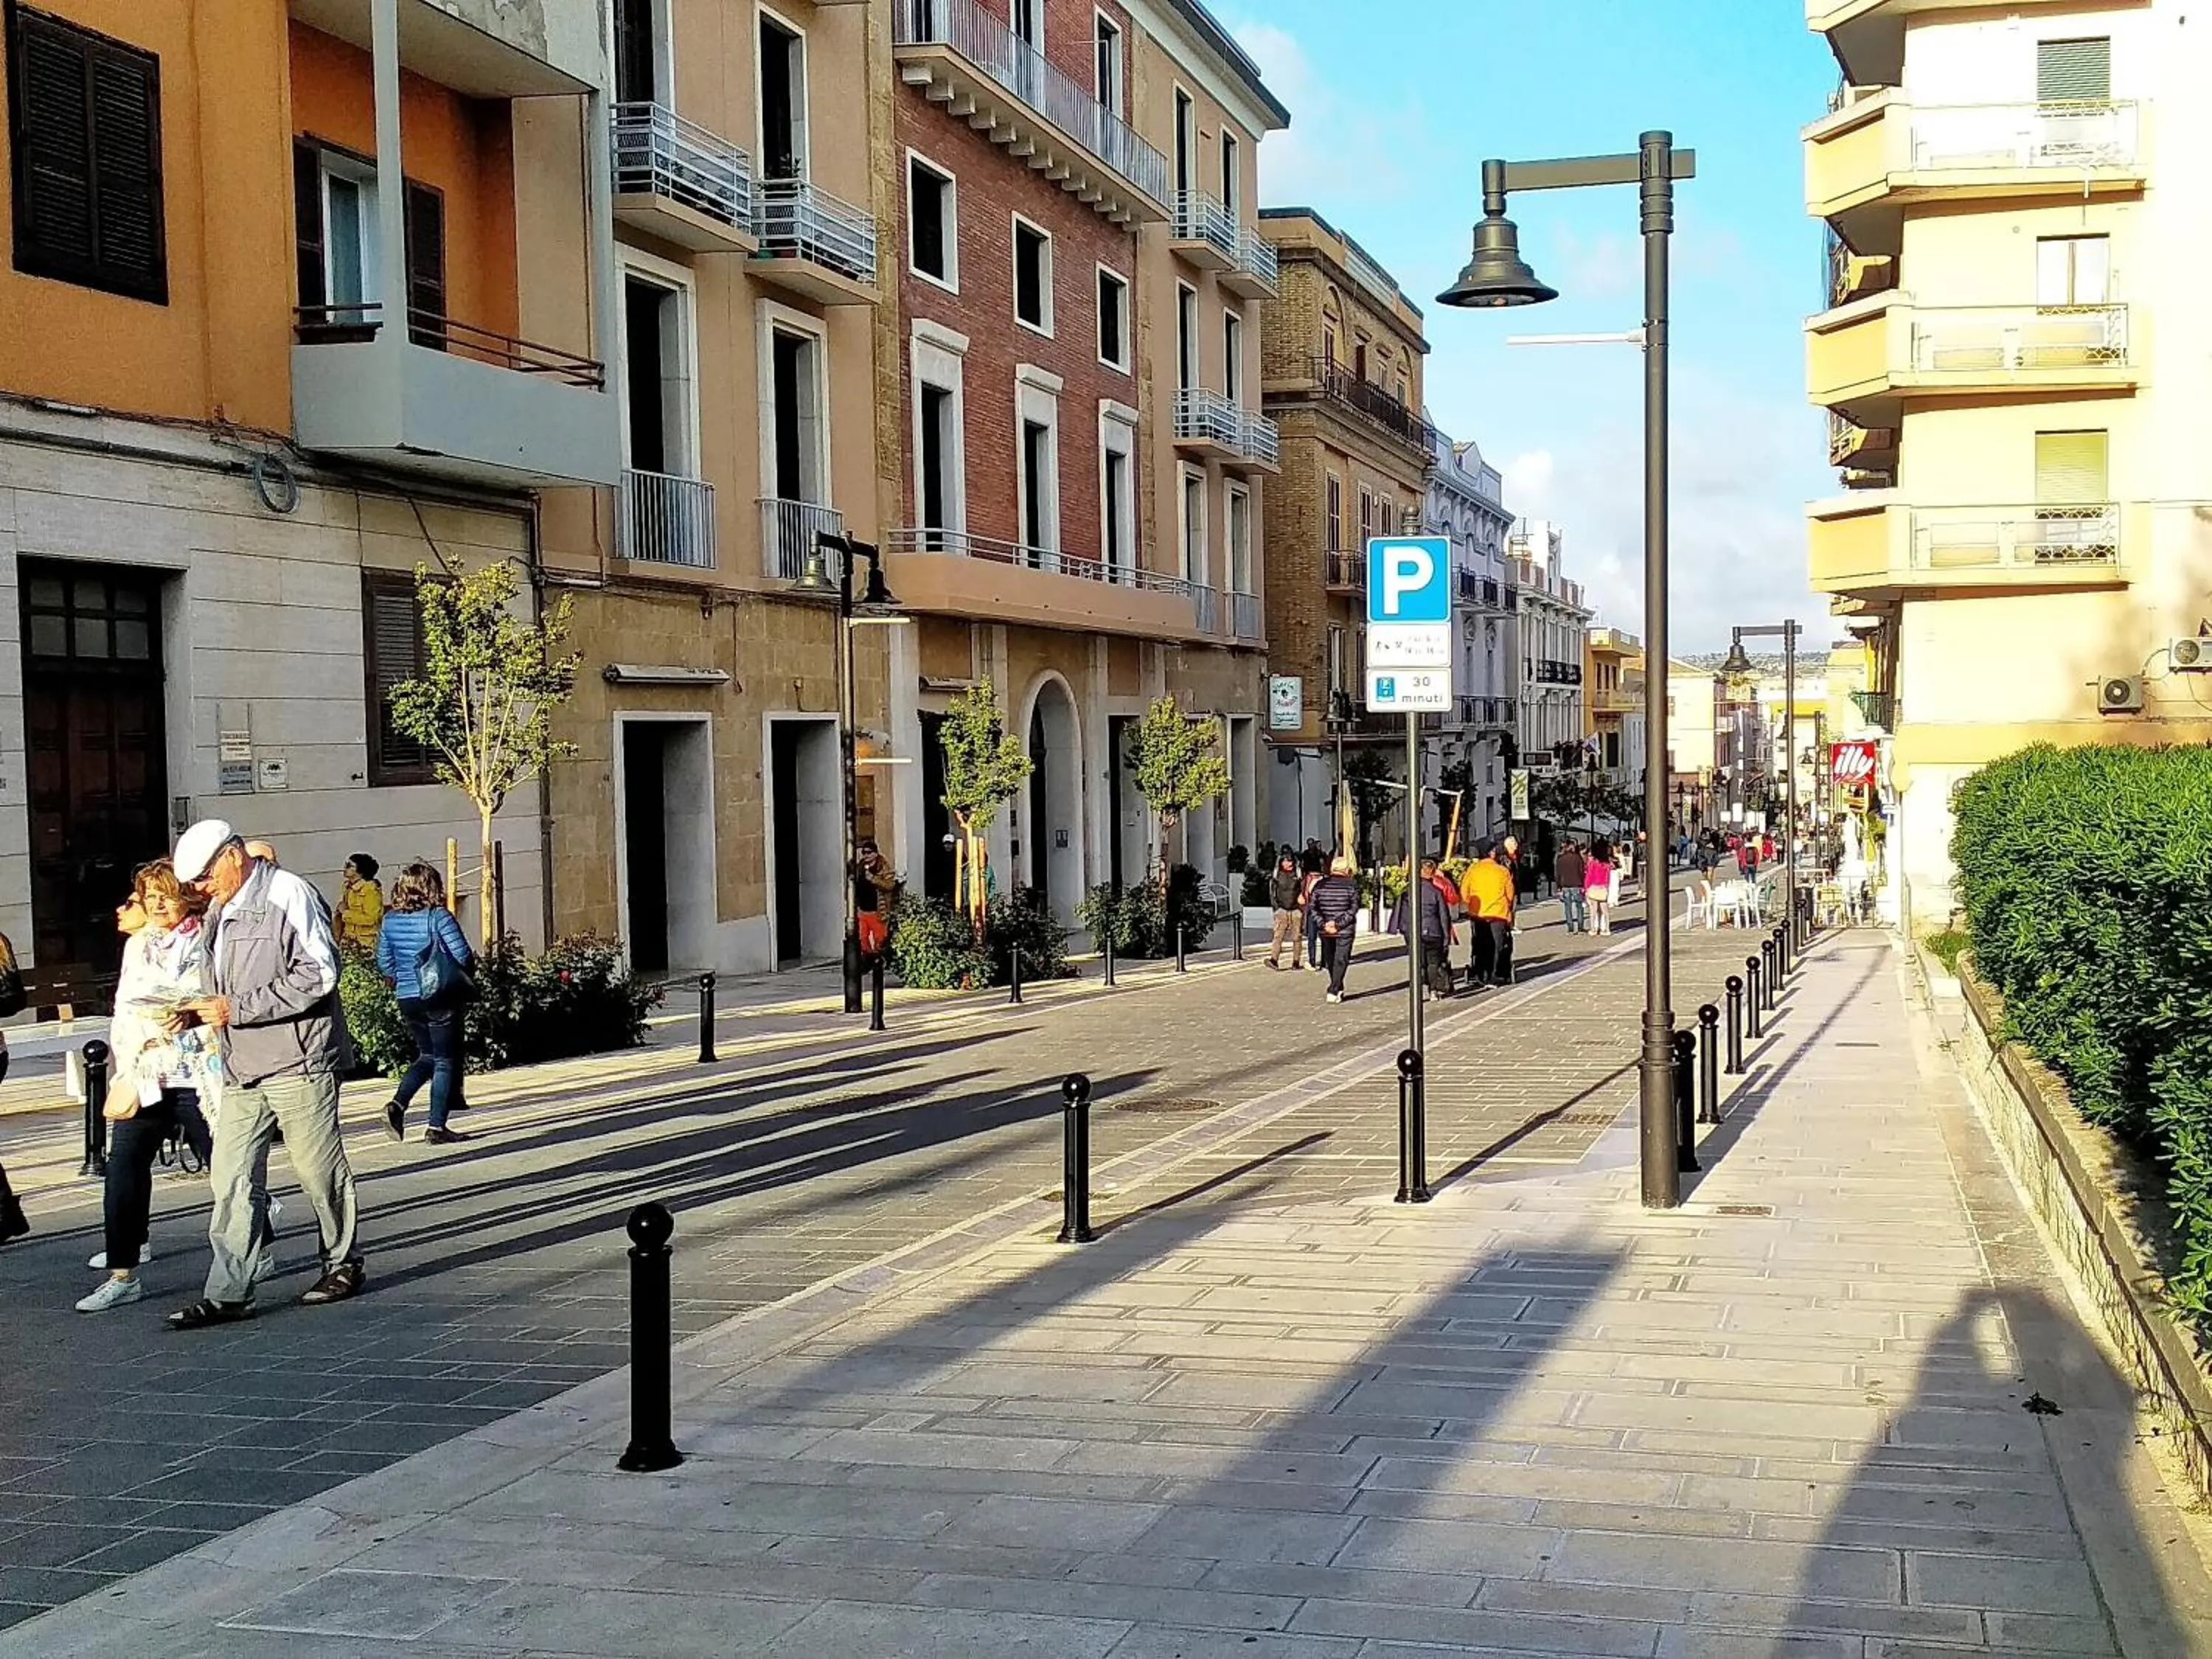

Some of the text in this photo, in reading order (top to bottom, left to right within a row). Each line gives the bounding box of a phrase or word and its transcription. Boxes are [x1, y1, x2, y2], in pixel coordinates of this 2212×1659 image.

[1382, 545, 1435, 615] P
[1413, 676, 1430, 687] 30
[1402, 693, 1443, 703] minuti
[1834, 745, 1874, 780] illy
